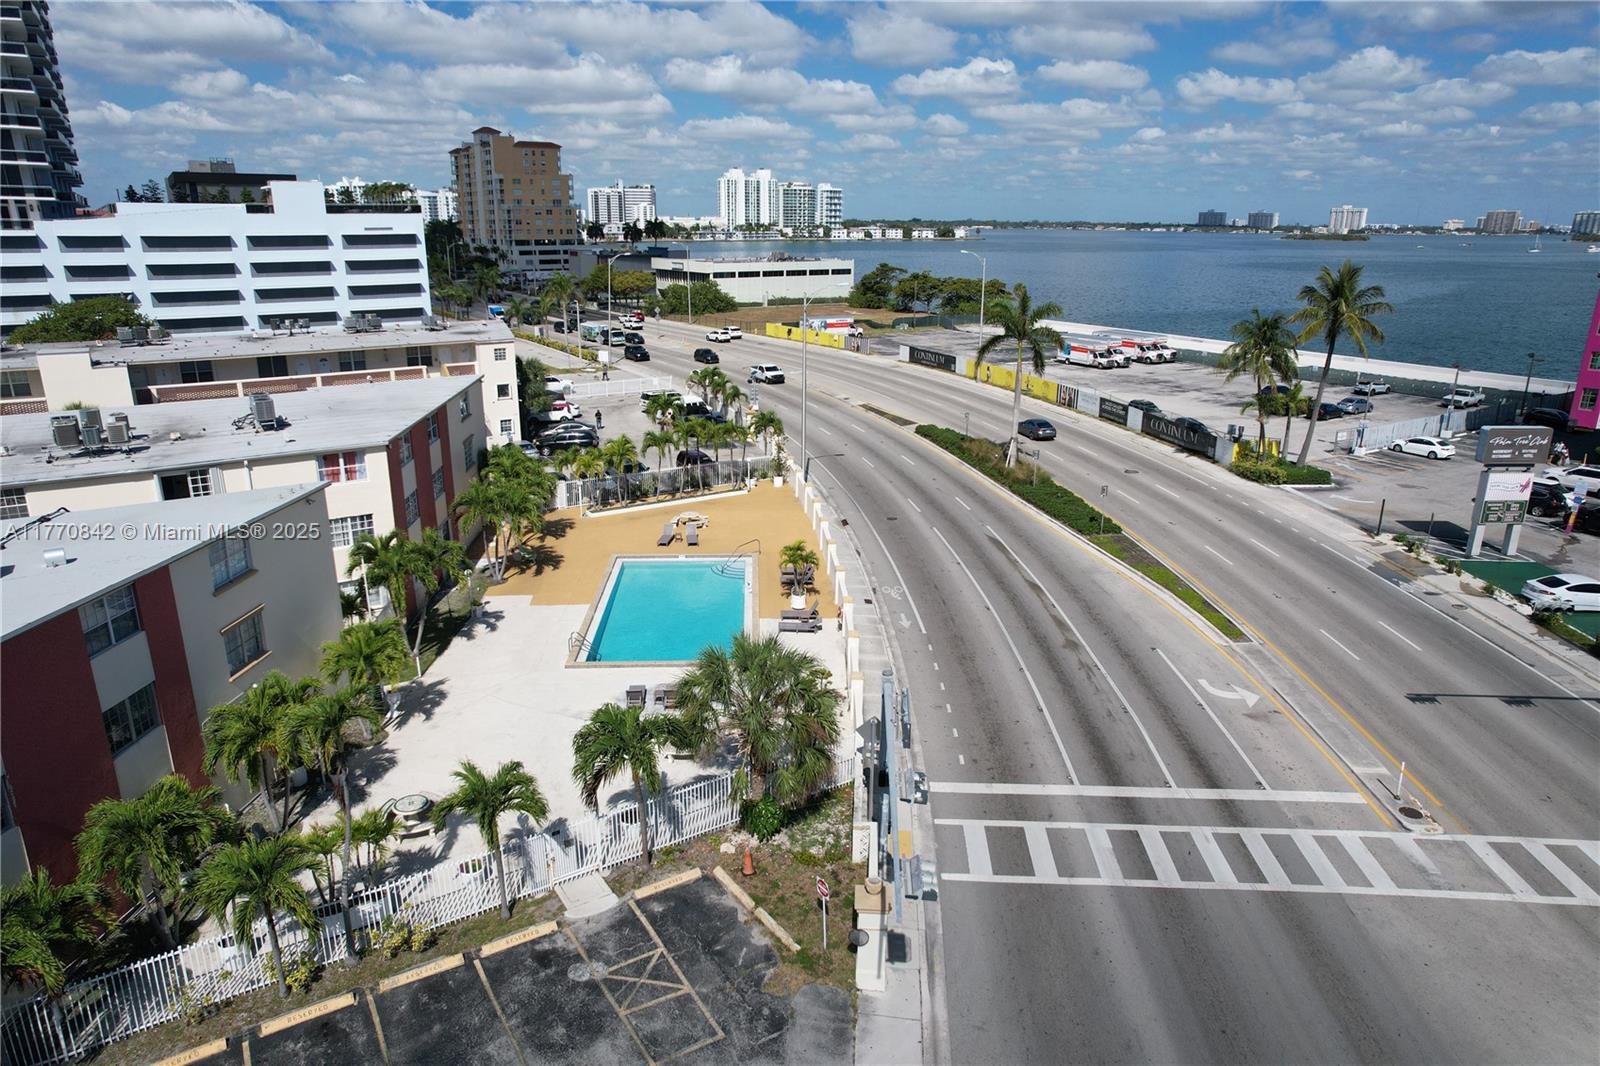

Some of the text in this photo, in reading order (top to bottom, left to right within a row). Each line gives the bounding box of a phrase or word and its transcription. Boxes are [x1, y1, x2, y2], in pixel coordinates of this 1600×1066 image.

[1150, 419, 1199, 445] CONTINUUM
[1489, 436, 1550, 446] Palm Tree Club
[287, 1004, 329, 1024] RESERVED
